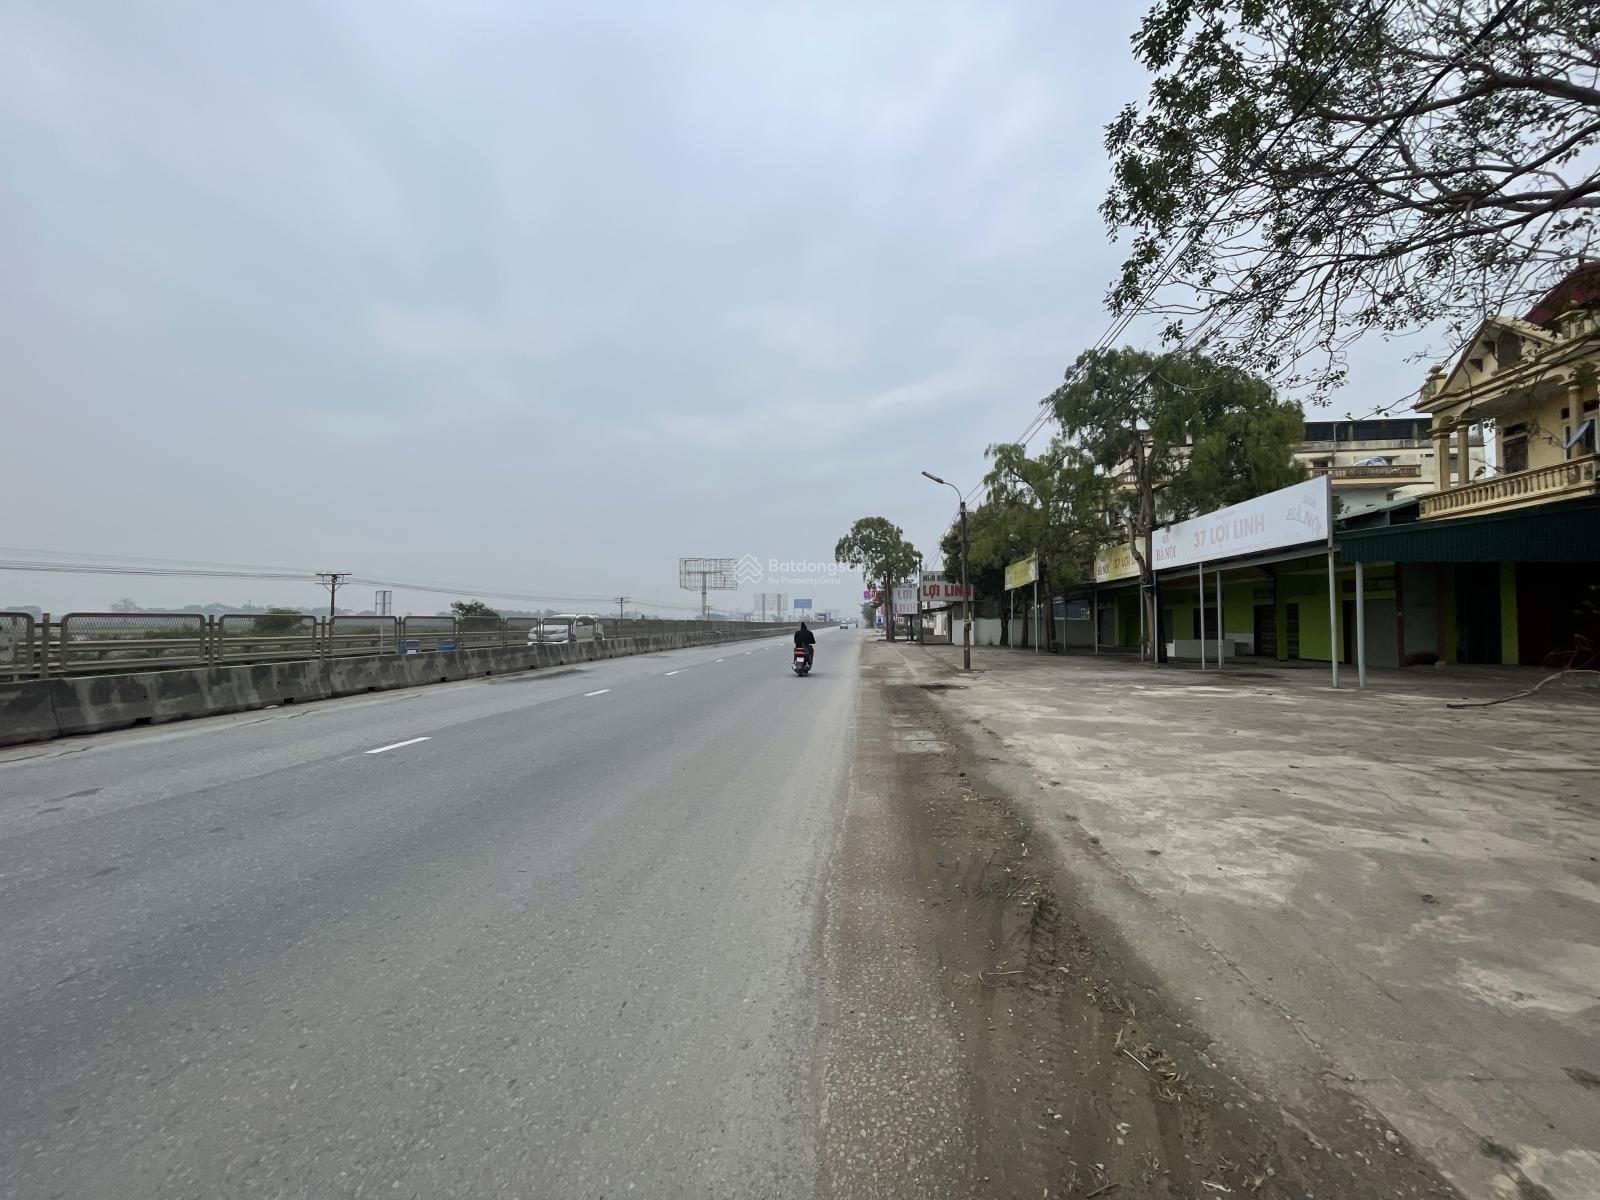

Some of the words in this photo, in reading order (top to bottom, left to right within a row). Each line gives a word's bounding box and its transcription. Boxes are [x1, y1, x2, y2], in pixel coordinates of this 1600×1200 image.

[1193, 530, 1207, 548] 37
[1210, 520, 1230, 548] LỢI
[1233, 512, 1265, 540] LINH
[922, 583, 940, 599] LỢI
[894, 603, 915, 613] LINH
